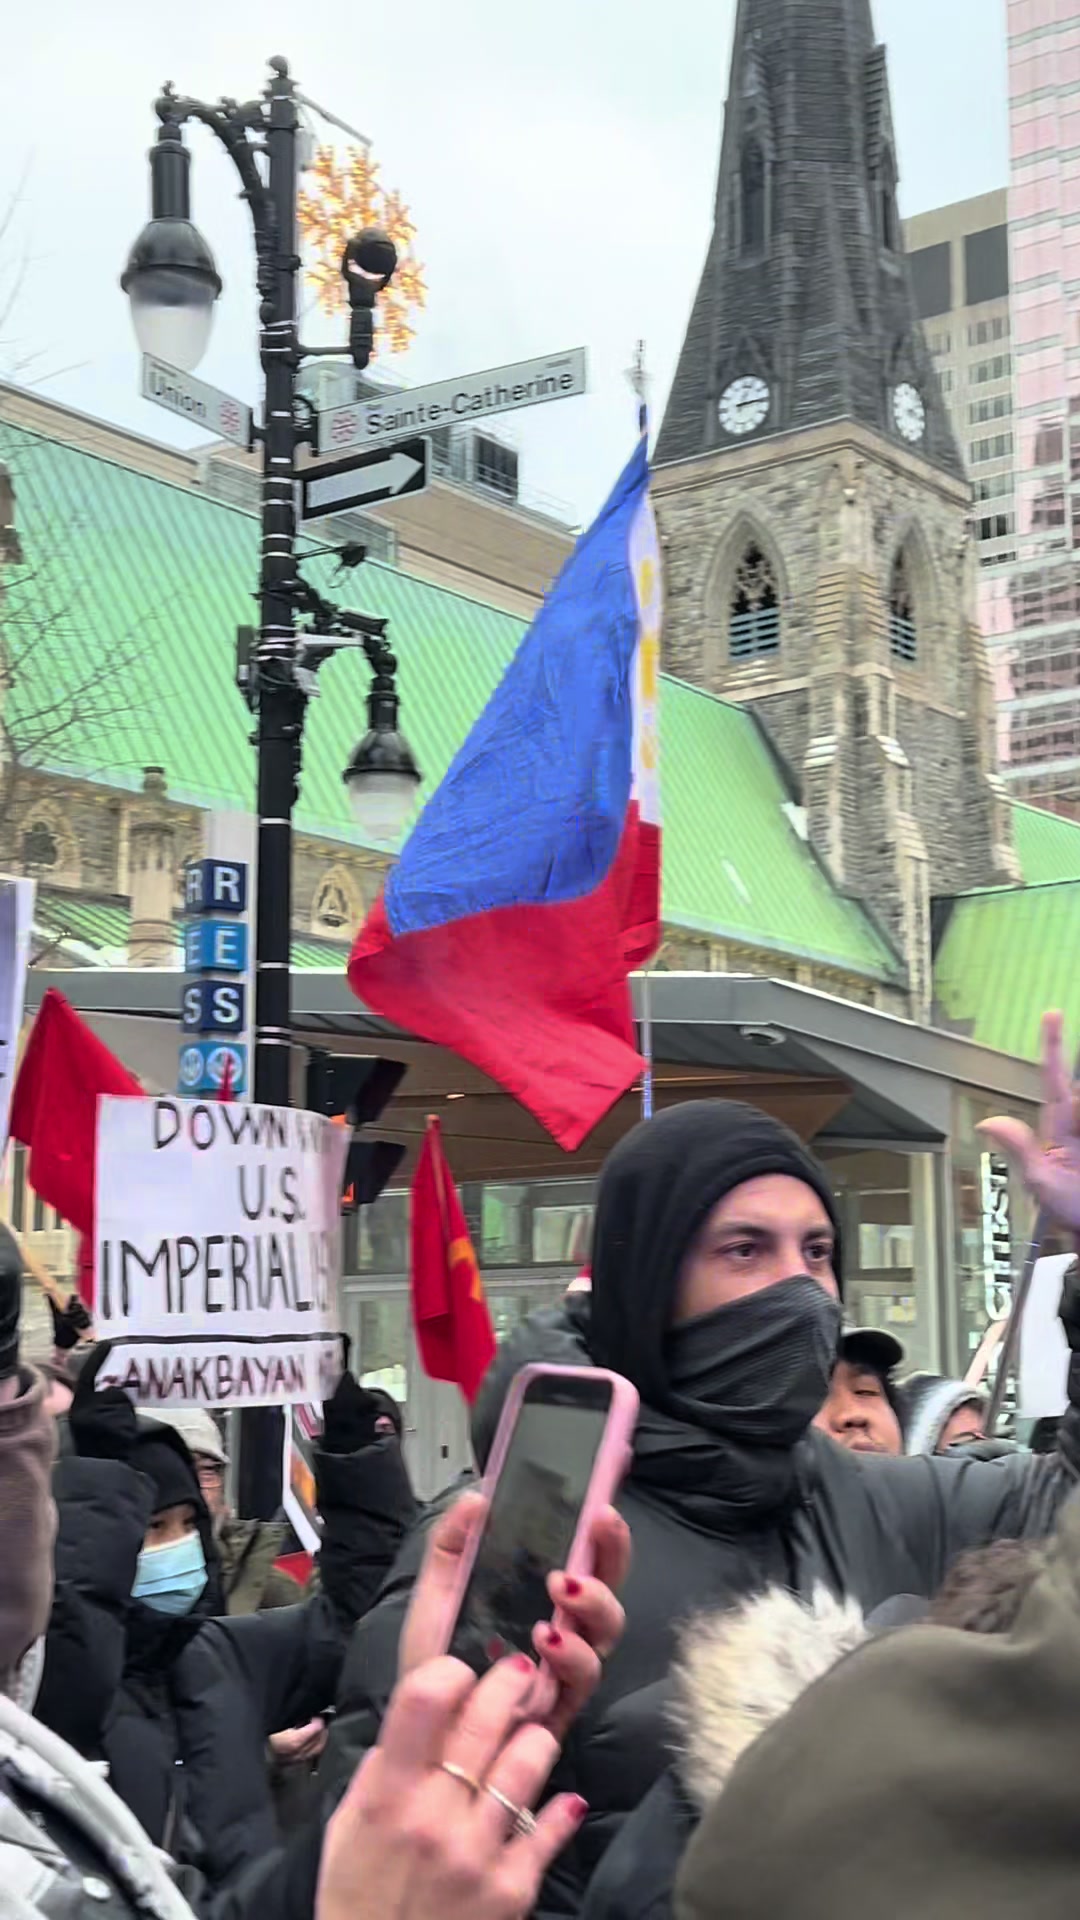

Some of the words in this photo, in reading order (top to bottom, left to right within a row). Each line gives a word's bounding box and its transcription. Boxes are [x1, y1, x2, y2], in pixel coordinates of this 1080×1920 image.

[149, 371, 206, 418] Union
[366, 372, 575, 435] Sainte-Catherine
[154, 1101, 288, 1150] DOWN
[239, 1164, 306, 1224] U.S.
